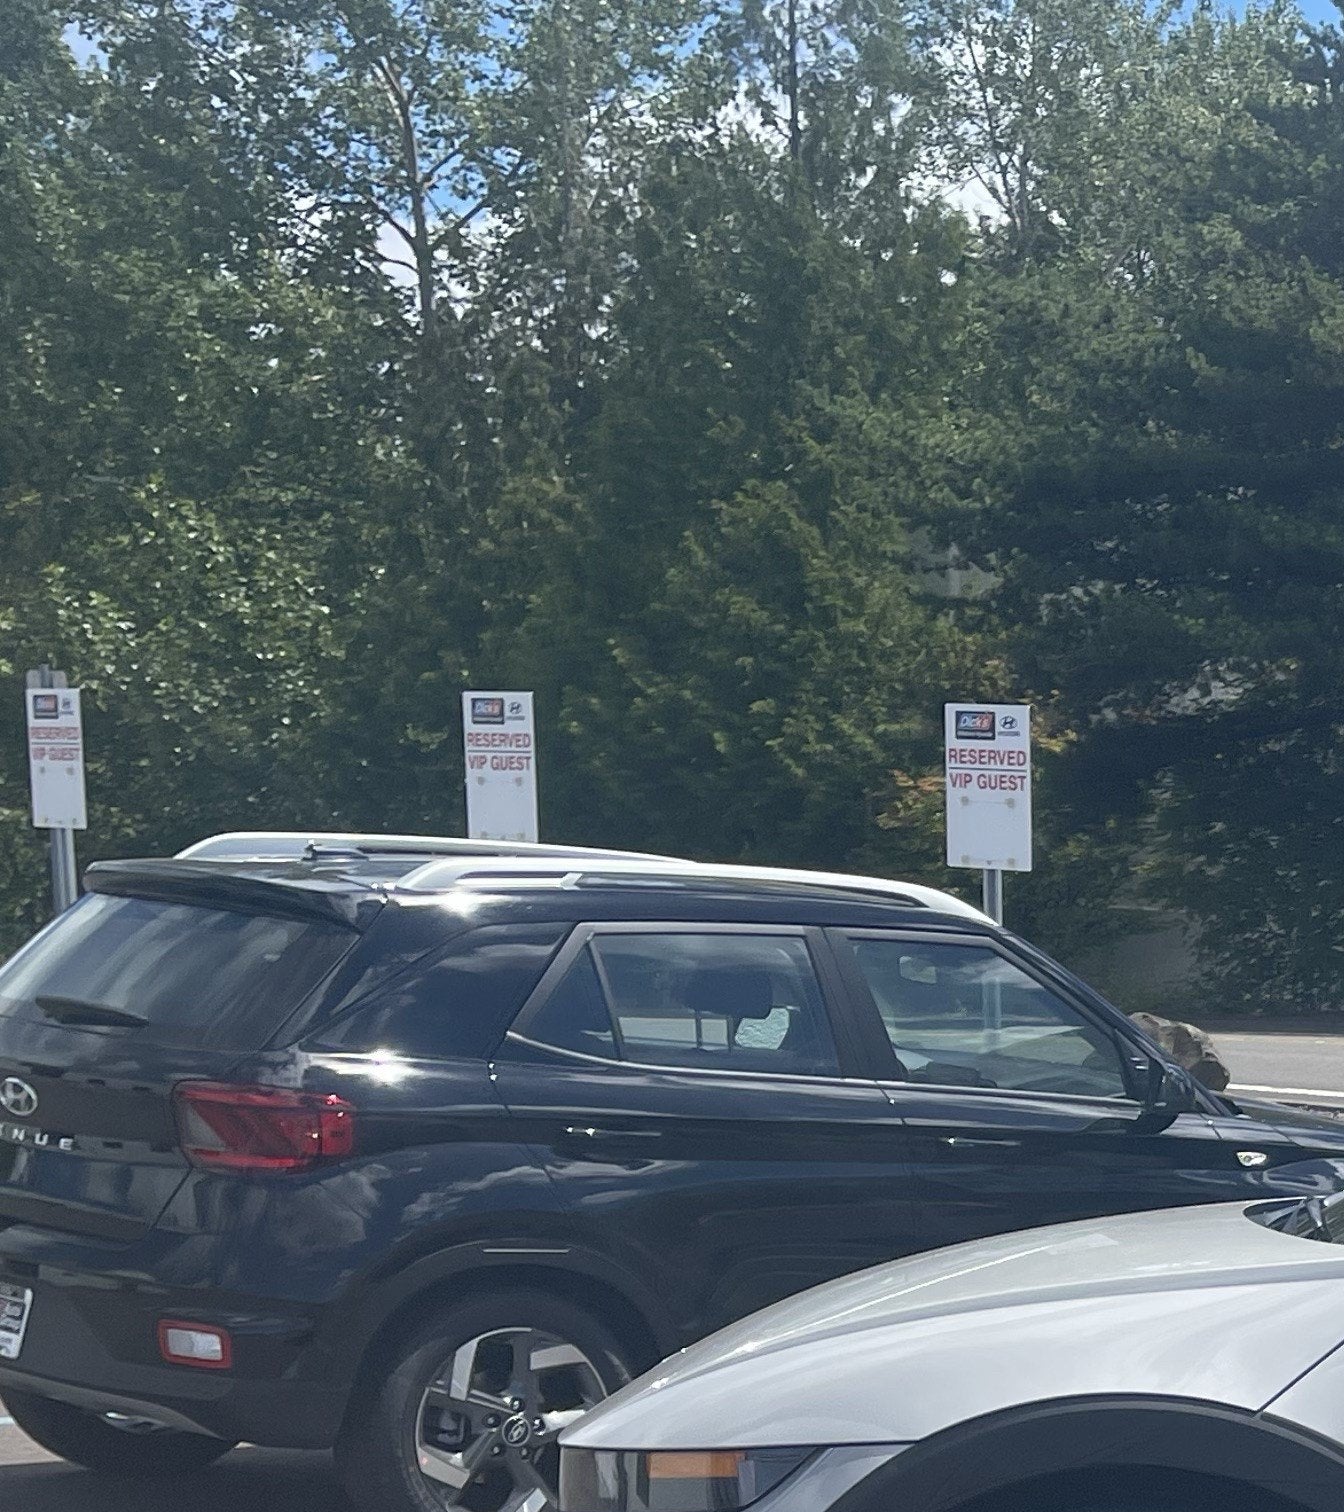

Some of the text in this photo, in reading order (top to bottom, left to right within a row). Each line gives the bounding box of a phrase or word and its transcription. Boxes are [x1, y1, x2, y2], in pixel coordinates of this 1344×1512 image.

[467, 732, 531, 748] RESERVED
[490, 755, 532, 771] GUEST
[949, 748, 1027, 767] RESERVED
[950, 773, 1027, 791] VIP GUEST
[0, 1123, 74, 1151] NUE
